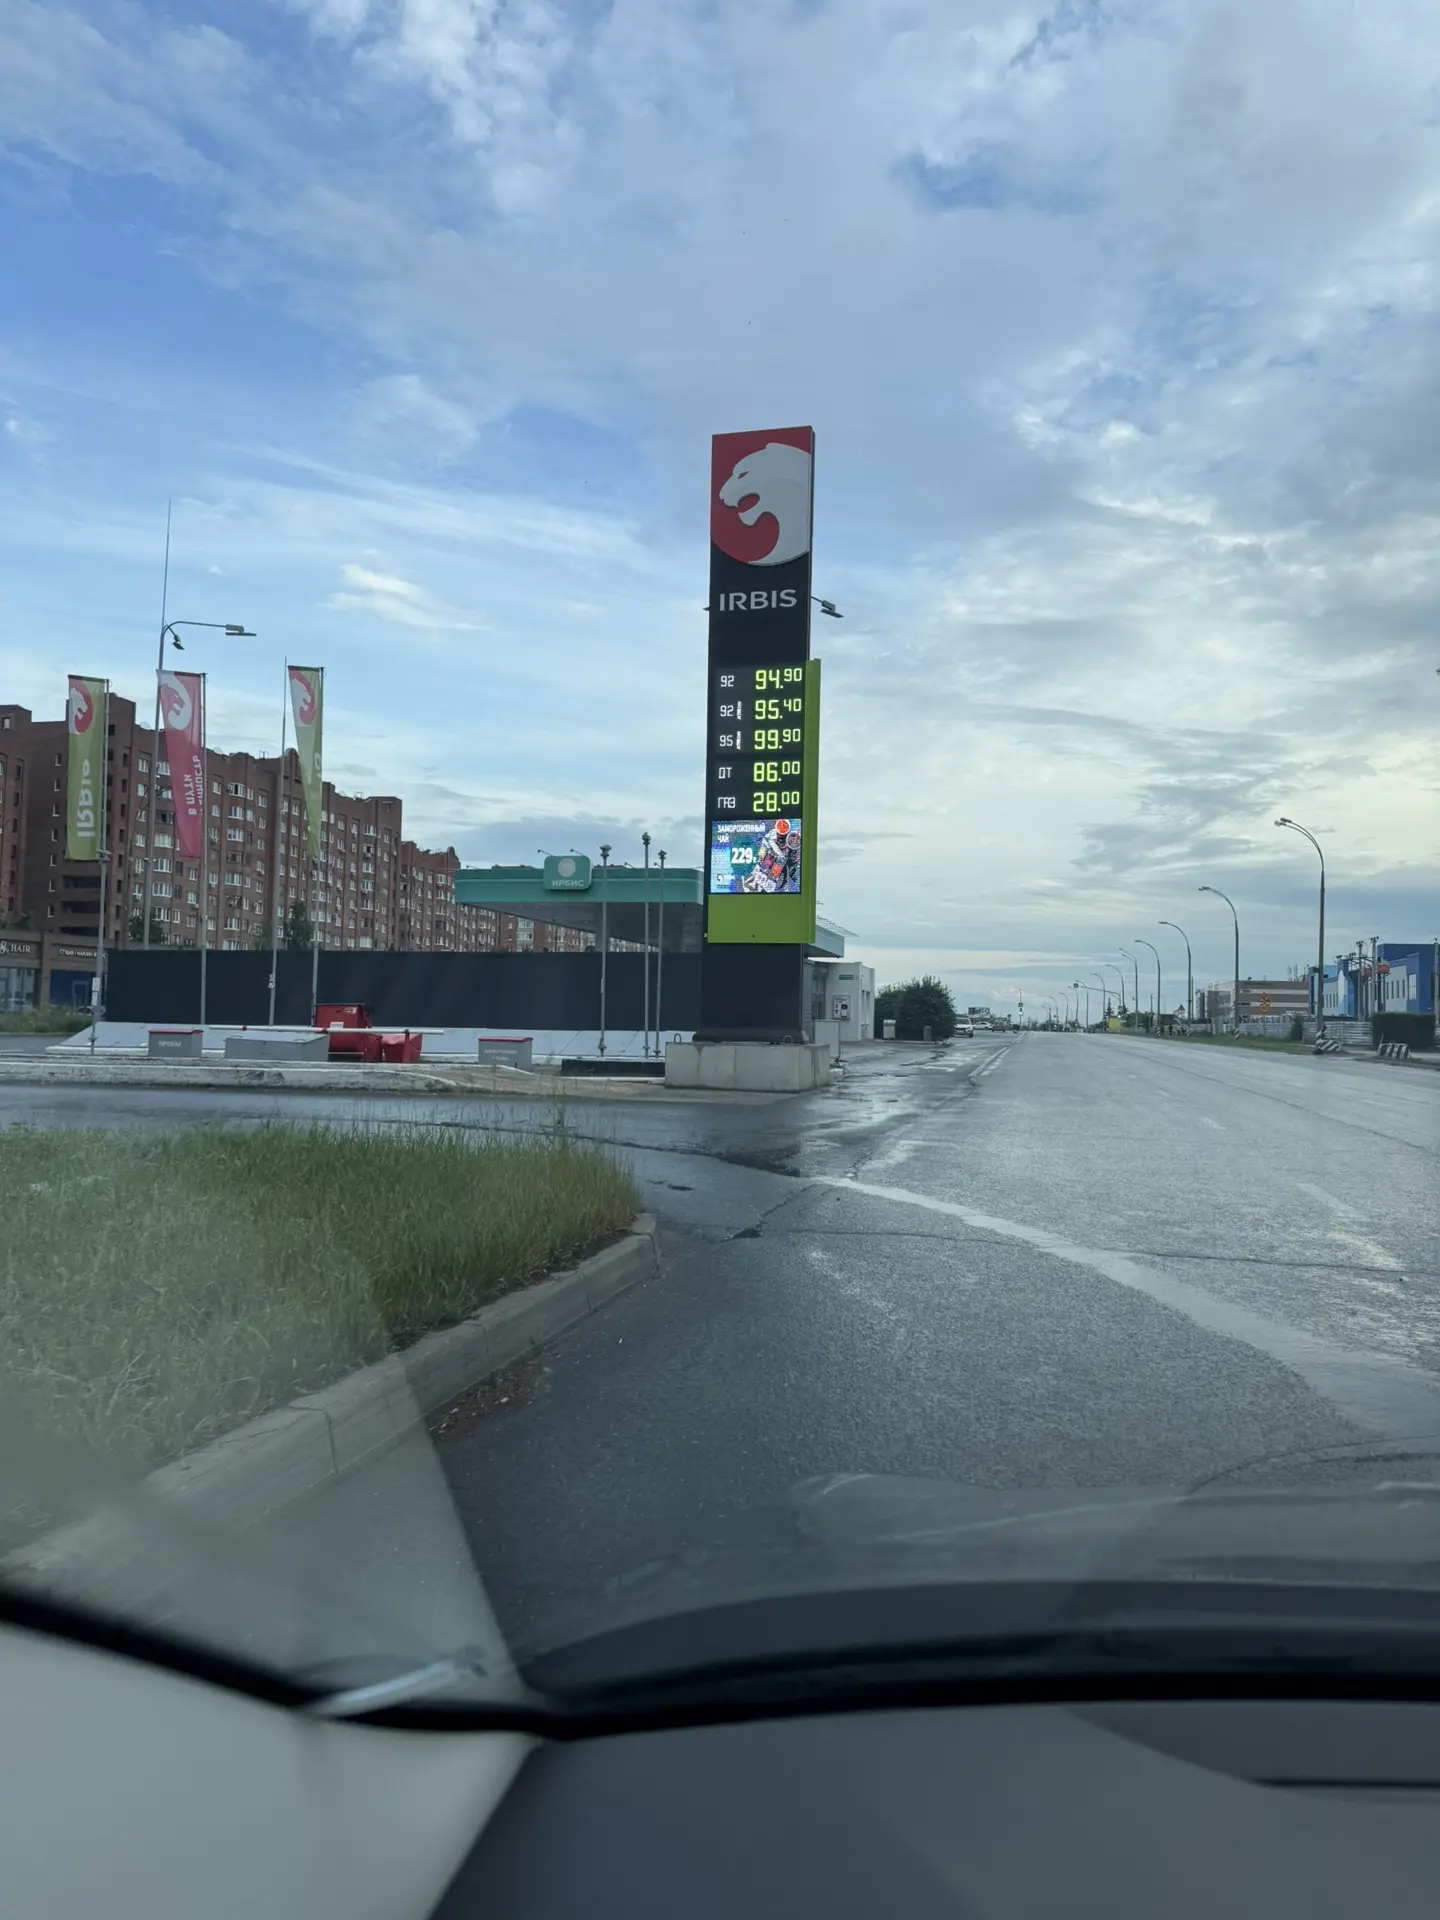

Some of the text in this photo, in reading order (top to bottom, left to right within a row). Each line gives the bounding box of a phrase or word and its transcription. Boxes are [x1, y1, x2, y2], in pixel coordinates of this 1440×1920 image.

[720, 589, 797, 611] IRBIS
[720, 668, 803, 690] 92 94.90
[720, 705, 734, 717] 92
[754, 698, 802, 720] 95.40
[719, 735, 733, 747] 95
[754, 728, 801, 750] 99.90
[753, 761, 801, 782] 86.00
[718, 792, 800, 812] ГАЗ 28.00
[552, 879, 585, 887] ИРБИС
[11, 943, 31, 953] HAIR
